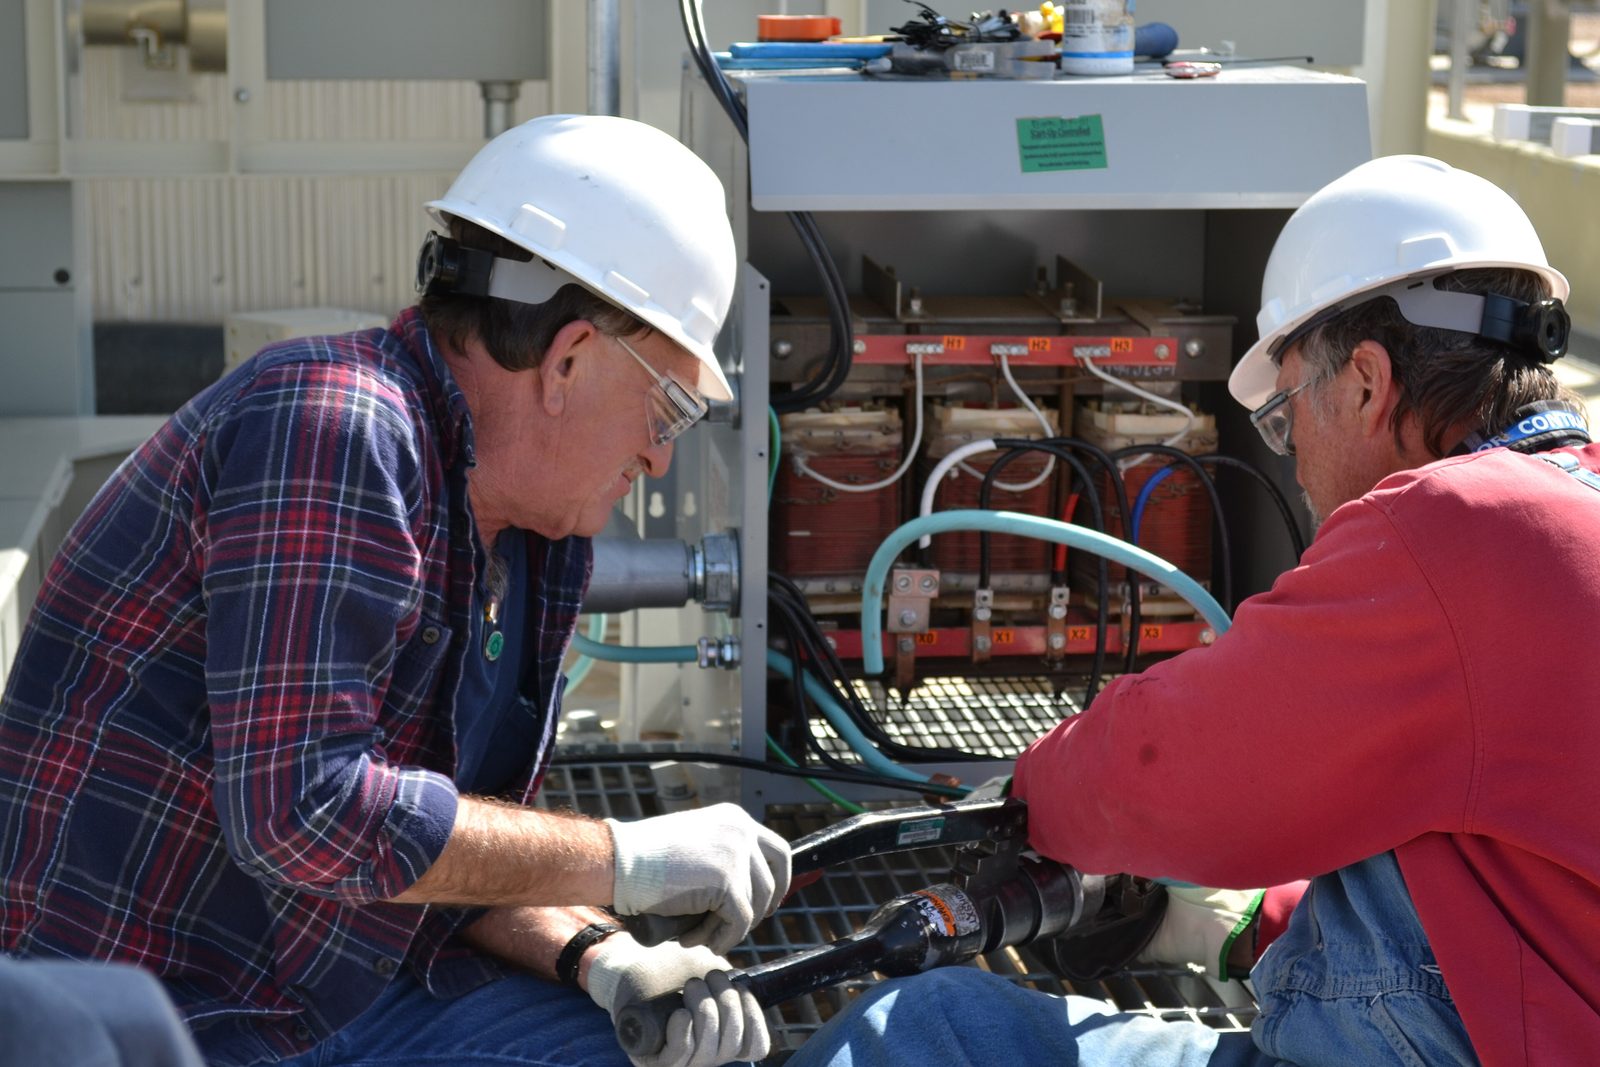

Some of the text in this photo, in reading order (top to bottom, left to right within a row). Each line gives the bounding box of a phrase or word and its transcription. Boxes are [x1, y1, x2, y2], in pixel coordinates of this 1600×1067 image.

[945, 338, 963, 349] H1
[1031, 338, 1049, 350] H2
[1114, 338, 1131, 350] H3
[918, 632, 935, 644] X0
[995, 631, 1012, 643] X1
[1071, 628, 1088, 640] X2
[1144, 627, 1161, 639] X3
